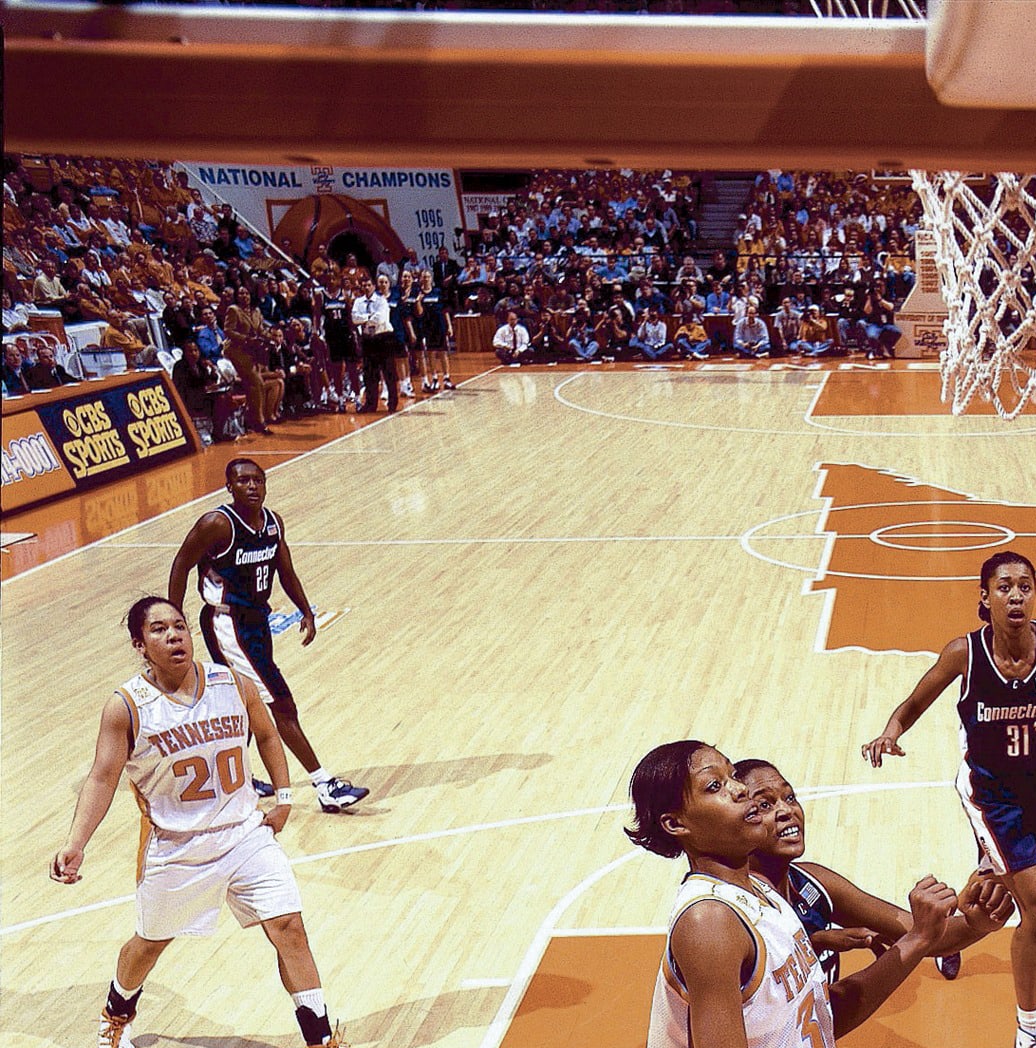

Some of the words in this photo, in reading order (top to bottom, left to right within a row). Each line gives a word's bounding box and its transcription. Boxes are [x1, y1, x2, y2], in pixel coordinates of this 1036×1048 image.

[199, 167, 302, 188] NATIONAL
[342, 171, 451, 188] CHAMPIONS
[415, 209, 444, 228] 1996
[419, 231, 445, 250] 1997
[75, 400, 112, 434] CBS
[138, 384, 171, 417] CBS
[127, 411, 183, 459] SPORTS
[63, 428, 126, 479] SPORTS
[256, 565, 269, 592] 22
[1006, 724, 1029, 757] 31
[172, 745, 246, 802] 20
